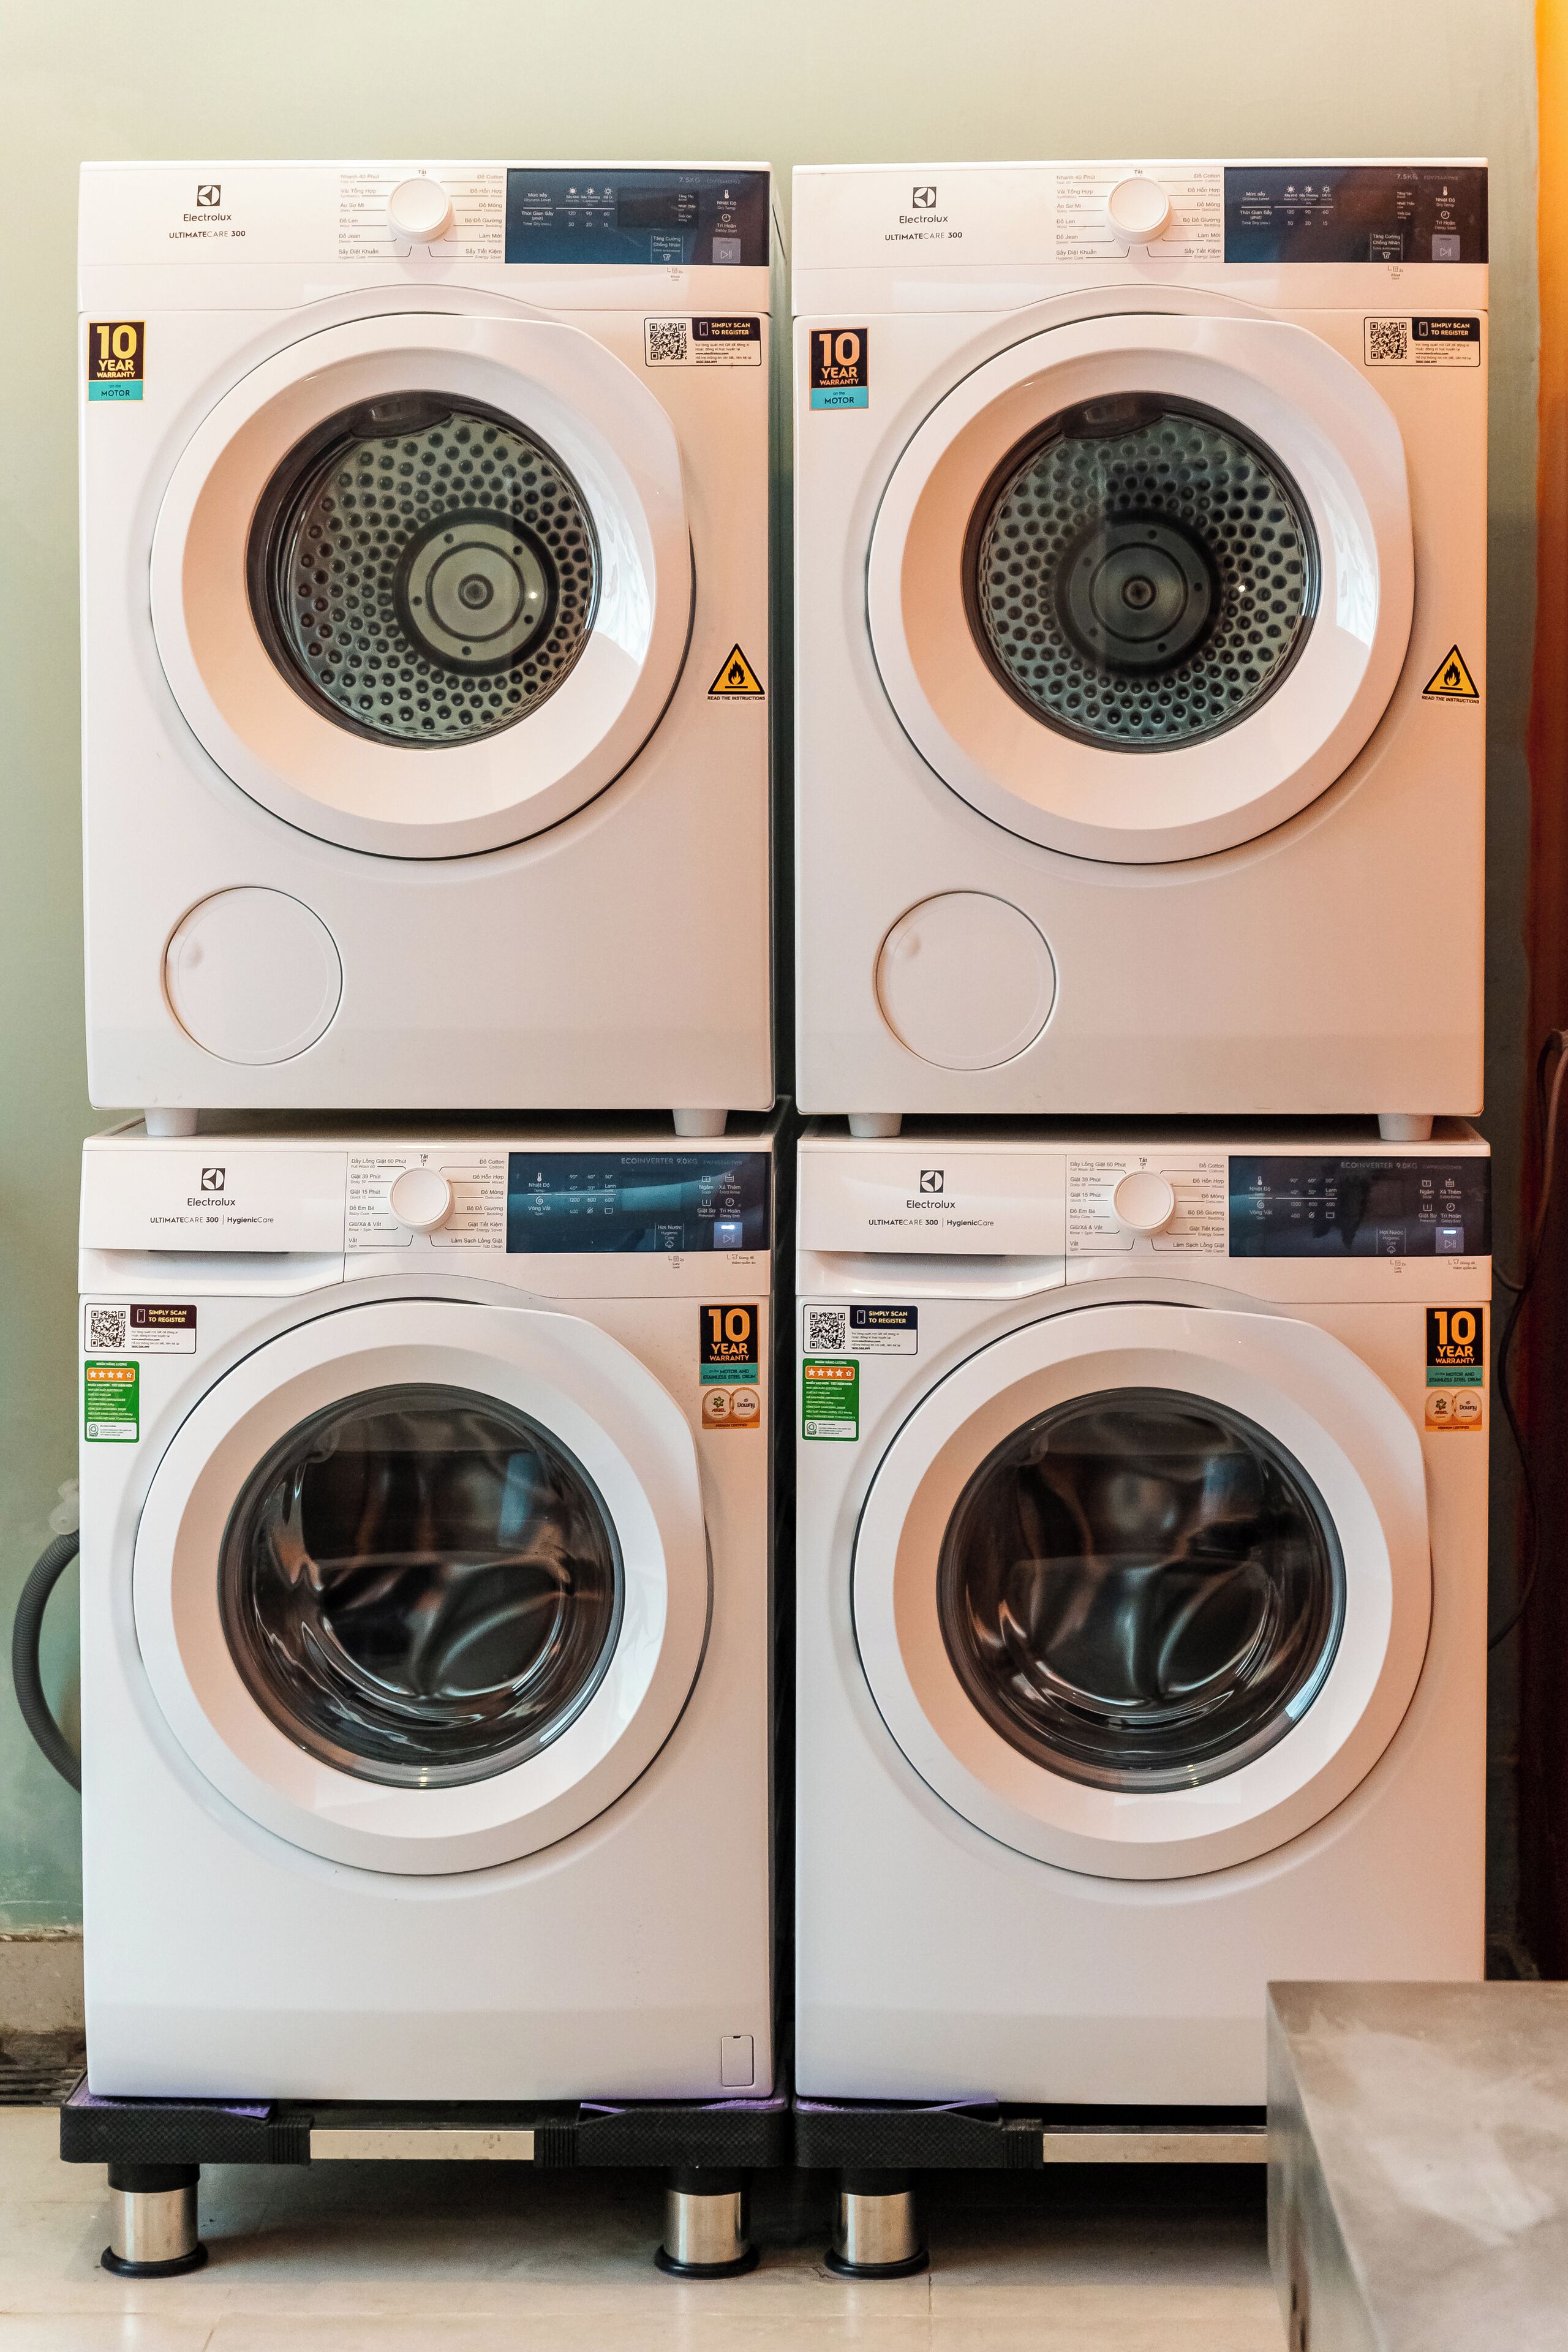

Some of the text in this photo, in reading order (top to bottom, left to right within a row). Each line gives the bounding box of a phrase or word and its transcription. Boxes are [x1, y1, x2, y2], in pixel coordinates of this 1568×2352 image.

[97, 325, 137, 359] 10
[820, 332, 859, 366] 10
[99, 360, 134, 371] YEAR
[821, 367, 857, 379] YEAR
[709, 1308, 750, 1342] 10
[1434, 1311, 1476, 1345] 10
[711, 1343, 747, 1354] YEAR
[1437, 1346, 1473, 1357] YEAR
